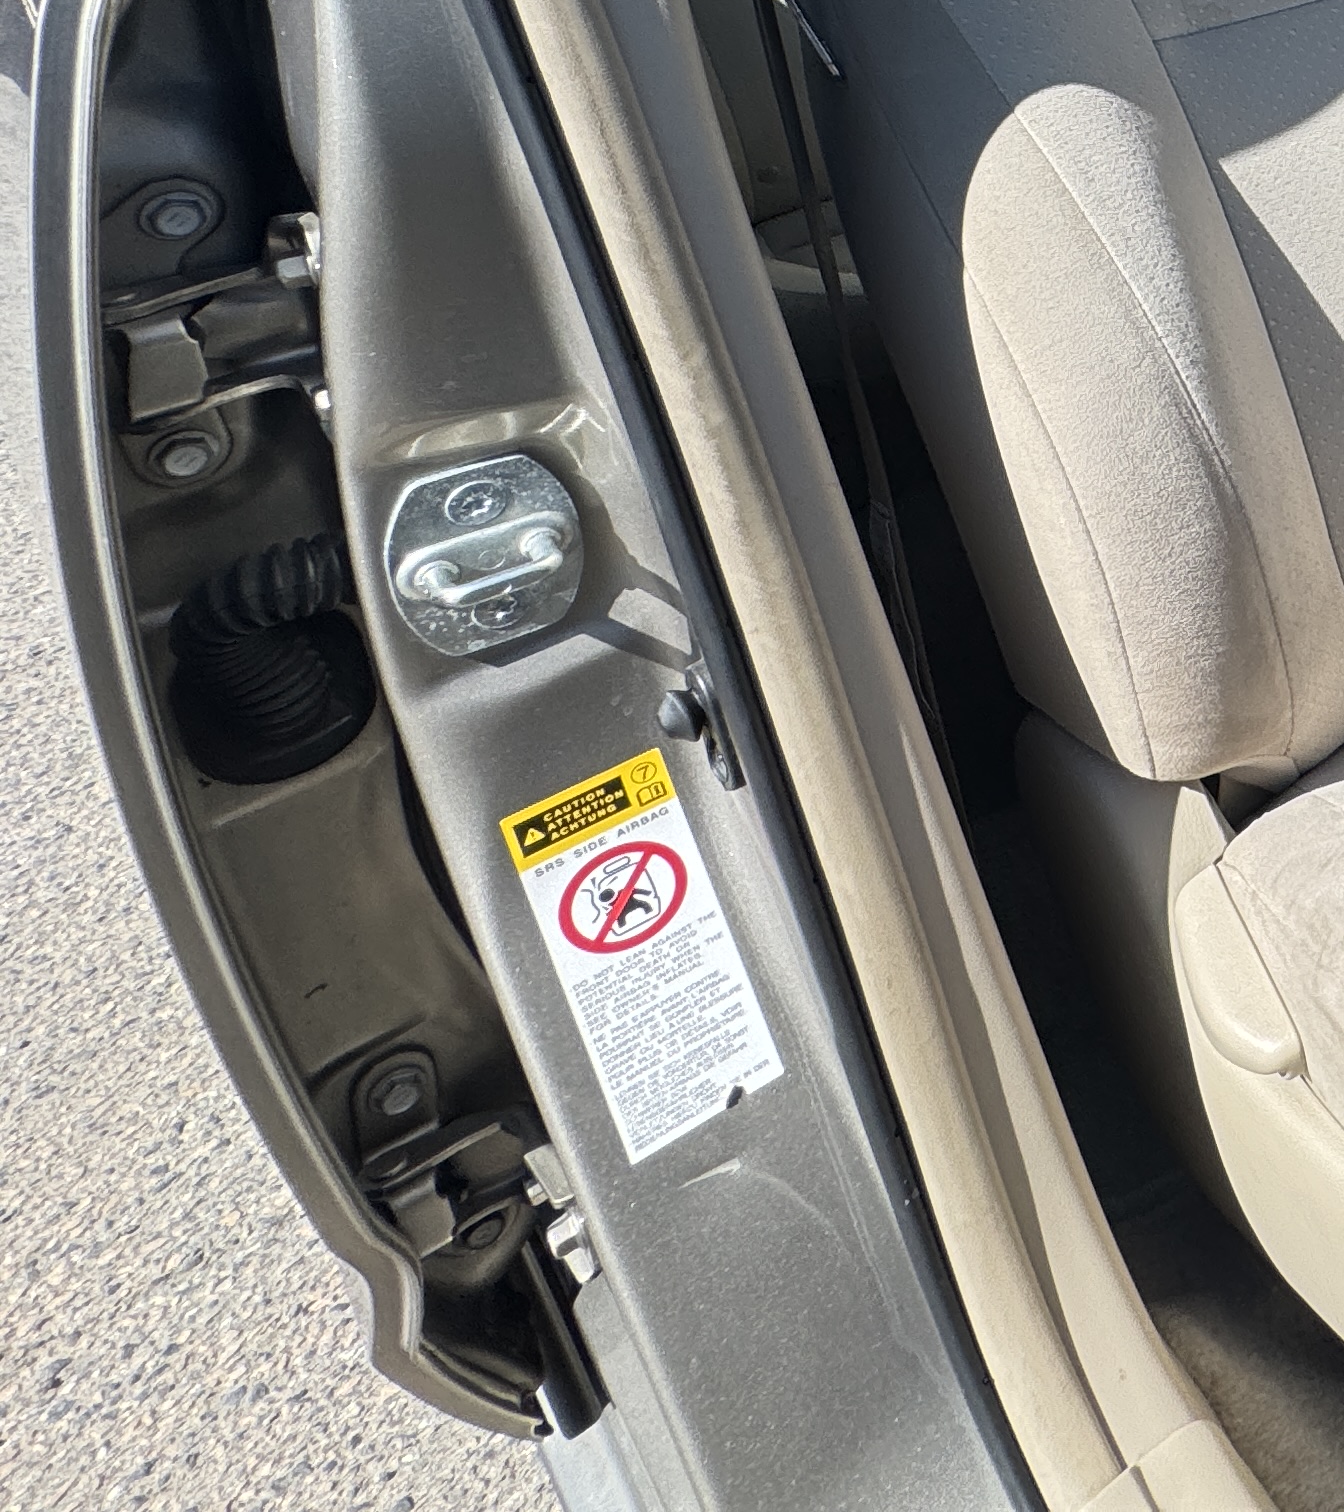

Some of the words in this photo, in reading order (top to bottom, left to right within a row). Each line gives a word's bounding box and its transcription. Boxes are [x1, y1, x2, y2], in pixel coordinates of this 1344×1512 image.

[636, 764, 650, 781] 7
[542, 787, 605, 822] CAUTION
[546, 789, 624, 831] ATTENTION
[549, 803, 616, 840] ACHTUNG
[534, 857, 564, 877] SRS
[573, 836, 607, 858] SIDE
[616, 806, 668, 836] AIRBAG
[573, 979, 587, 991] DO
[593, 965, 614, 980] NOT
[620, 948, 645, 965] LEAN
[651, 922, 692, 949] AGAINST
[698, 910, 716, 924] THE
[575, 976, 609, 999] FRONT
[615, 957, 644, 976] DOOR
[649, 947, 662, 957] TO
[668, 929, 697, 948] AVOID
[671, 943, 700, 964] WHEN
[704, 930, 723, 945] THE
[578, 972, 632, 1006] POTENTIAL
[584, 1003, 607, 1020] SIDE
[613, 979, 650, 1003] AIRBAG
